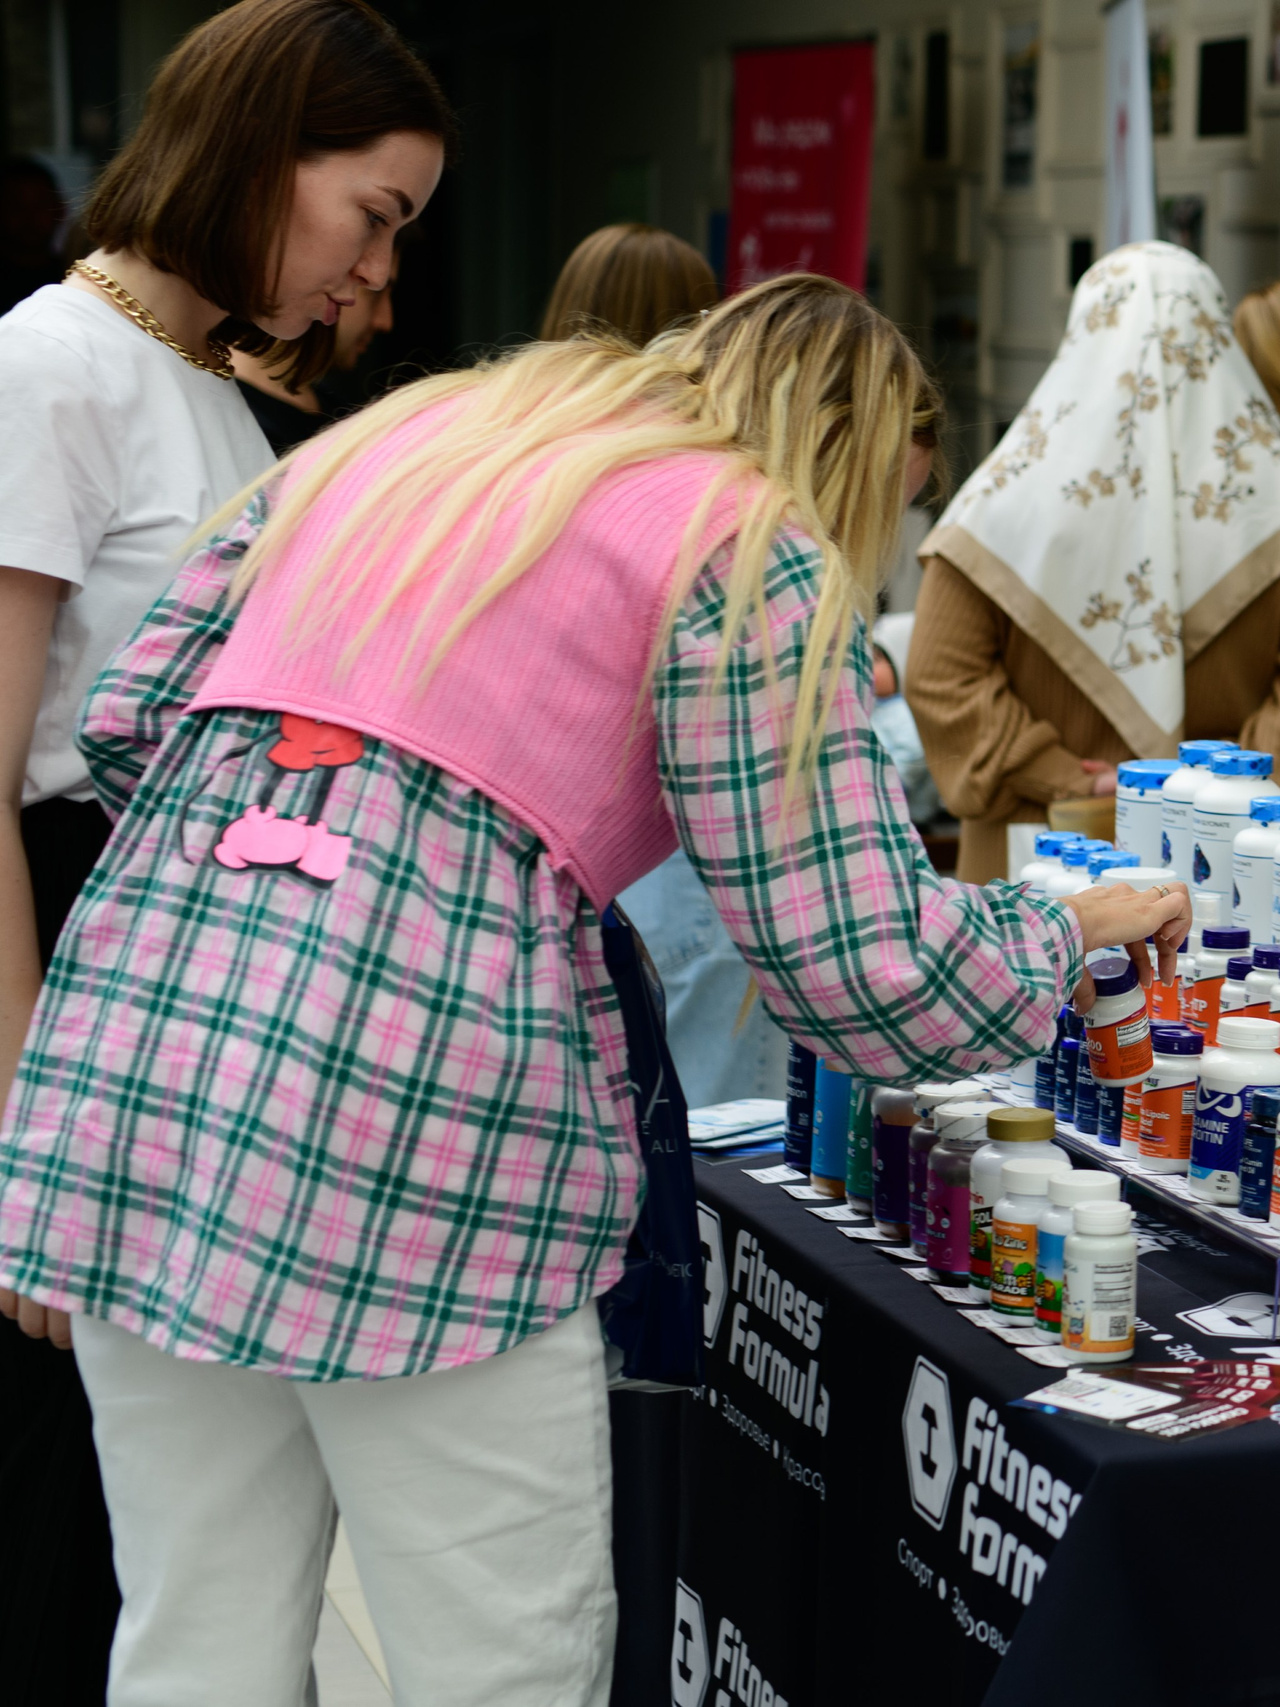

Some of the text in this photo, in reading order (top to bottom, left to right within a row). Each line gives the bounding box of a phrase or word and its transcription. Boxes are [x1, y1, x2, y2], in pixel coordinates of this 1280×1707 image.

[1004, 1234, 1027, 1250] Zinc
[732, 1229, 823, 1351] Fitness
[728, 1302, 830, 1437] Formula
[897, 1537, 935, 1589] Спорт
